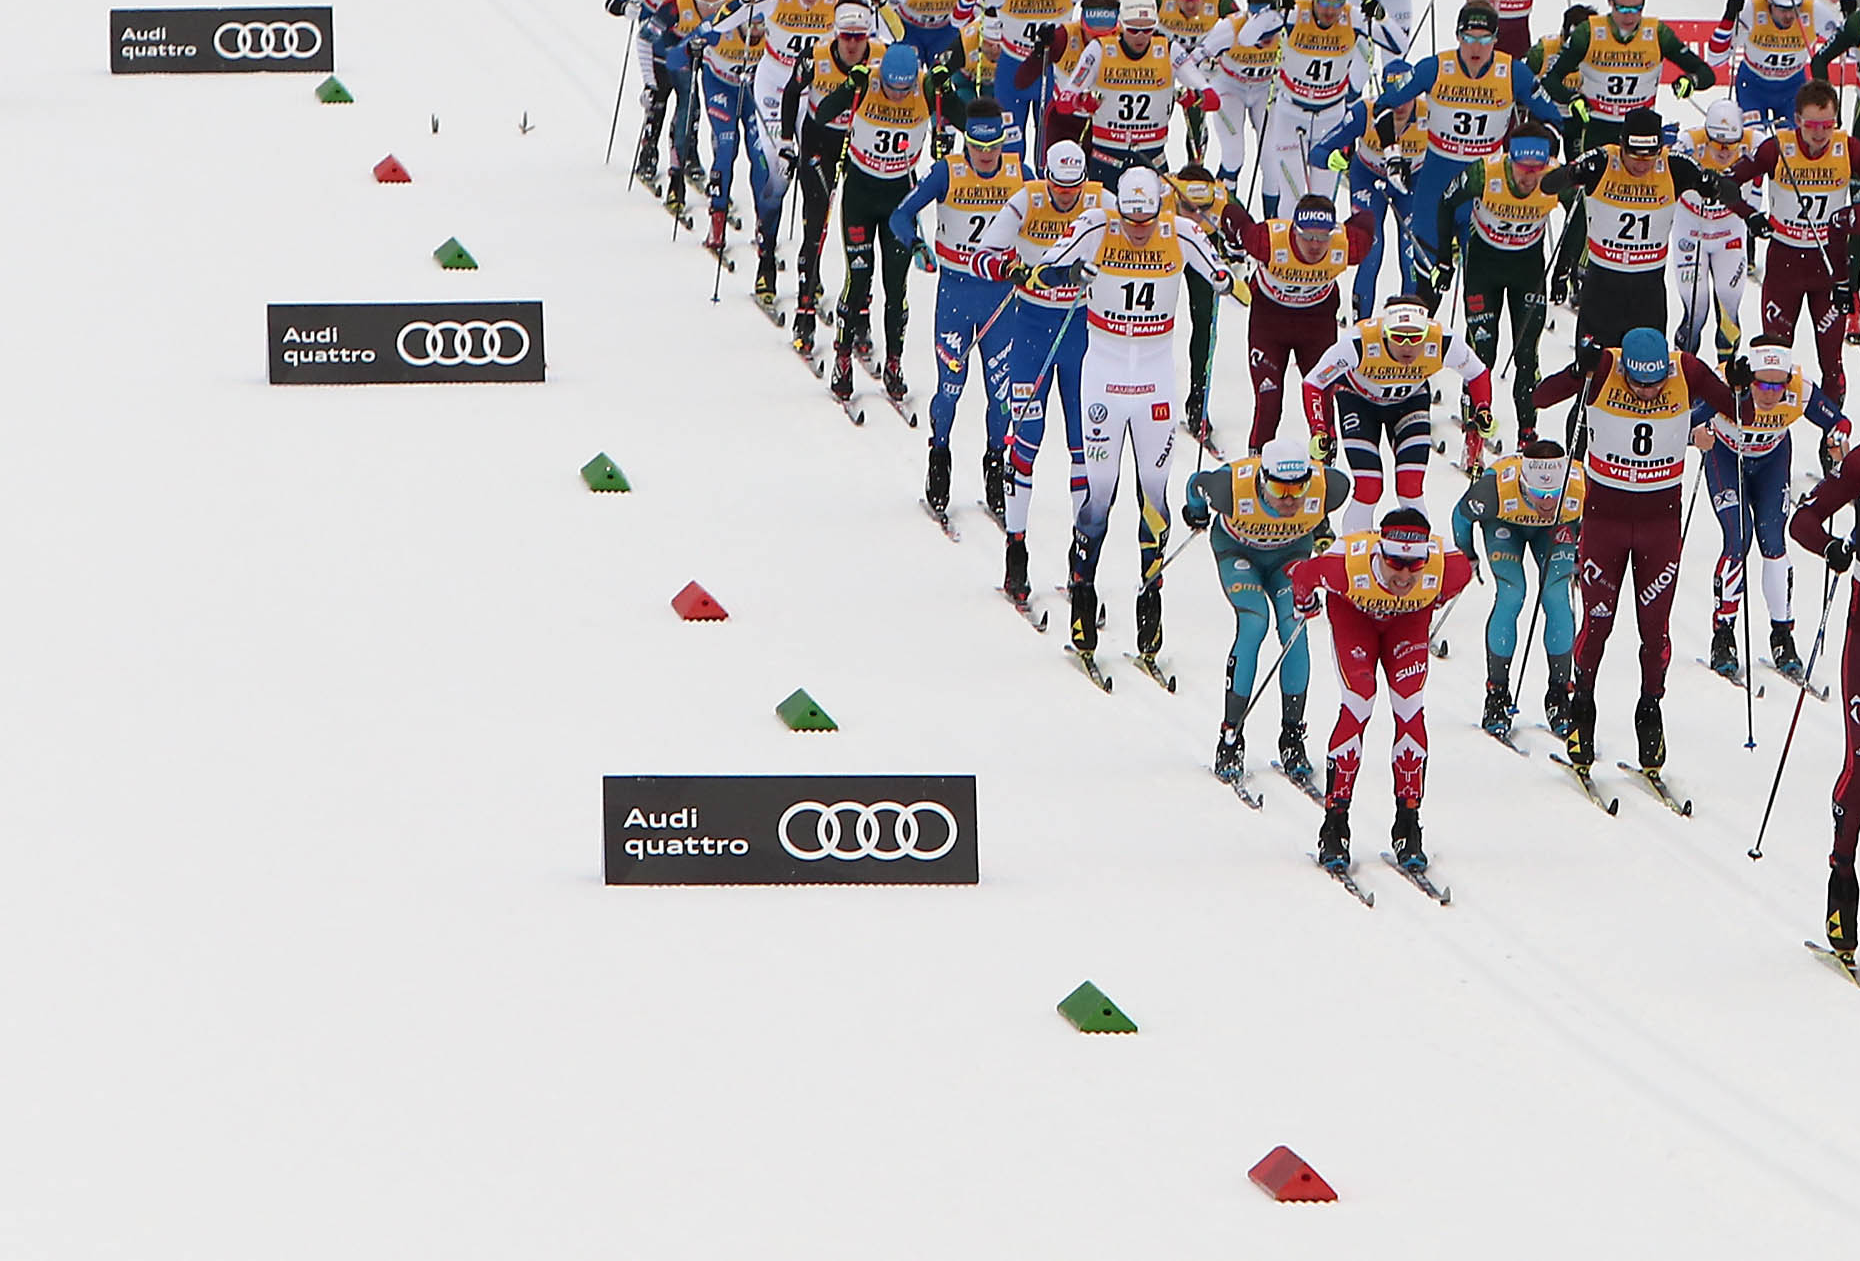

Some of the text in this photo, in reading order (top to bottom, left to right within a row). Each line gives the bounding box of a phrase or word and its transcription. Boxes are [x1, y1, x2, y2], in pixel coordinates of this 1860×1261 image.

[121, 27, 166, 41] Audi
[121, 44, 197, 61] quattro
[1306, 59, 1333, 81] 41
[1607, 75, 1639, 95] 37
[1118, 94, 1151, 120] 32
[1453, 111, 1486, 136] 31
[1110, 130, 1156, 140] VIESSMANN
[1298, 211, 1333, 222] LUKOIL
[1618, 213, 1651, 240] 21
[1103, 246, 1121, 260] LE
[1604, 249, 1659, 264] VIESSMANN
[1121, 282, 1155, 311] 14
[282, 326, 338, 344] Audi
[1107, 322, 1165, 334] VIESSMANN
[283, 349, 376, 367] quattro
[1625, 357, 1666, 372] LUKOIL
[1631, 422, 1654, 457] 8
[1609, 466, 1671, 481] VIESSMANN
[1639, 559, 1679, 607] LUKOIL
[1395, 660, 1428, 682] swix
[623, 808, 698, 829] Audi
[624, 837, 750, 860] quattro
